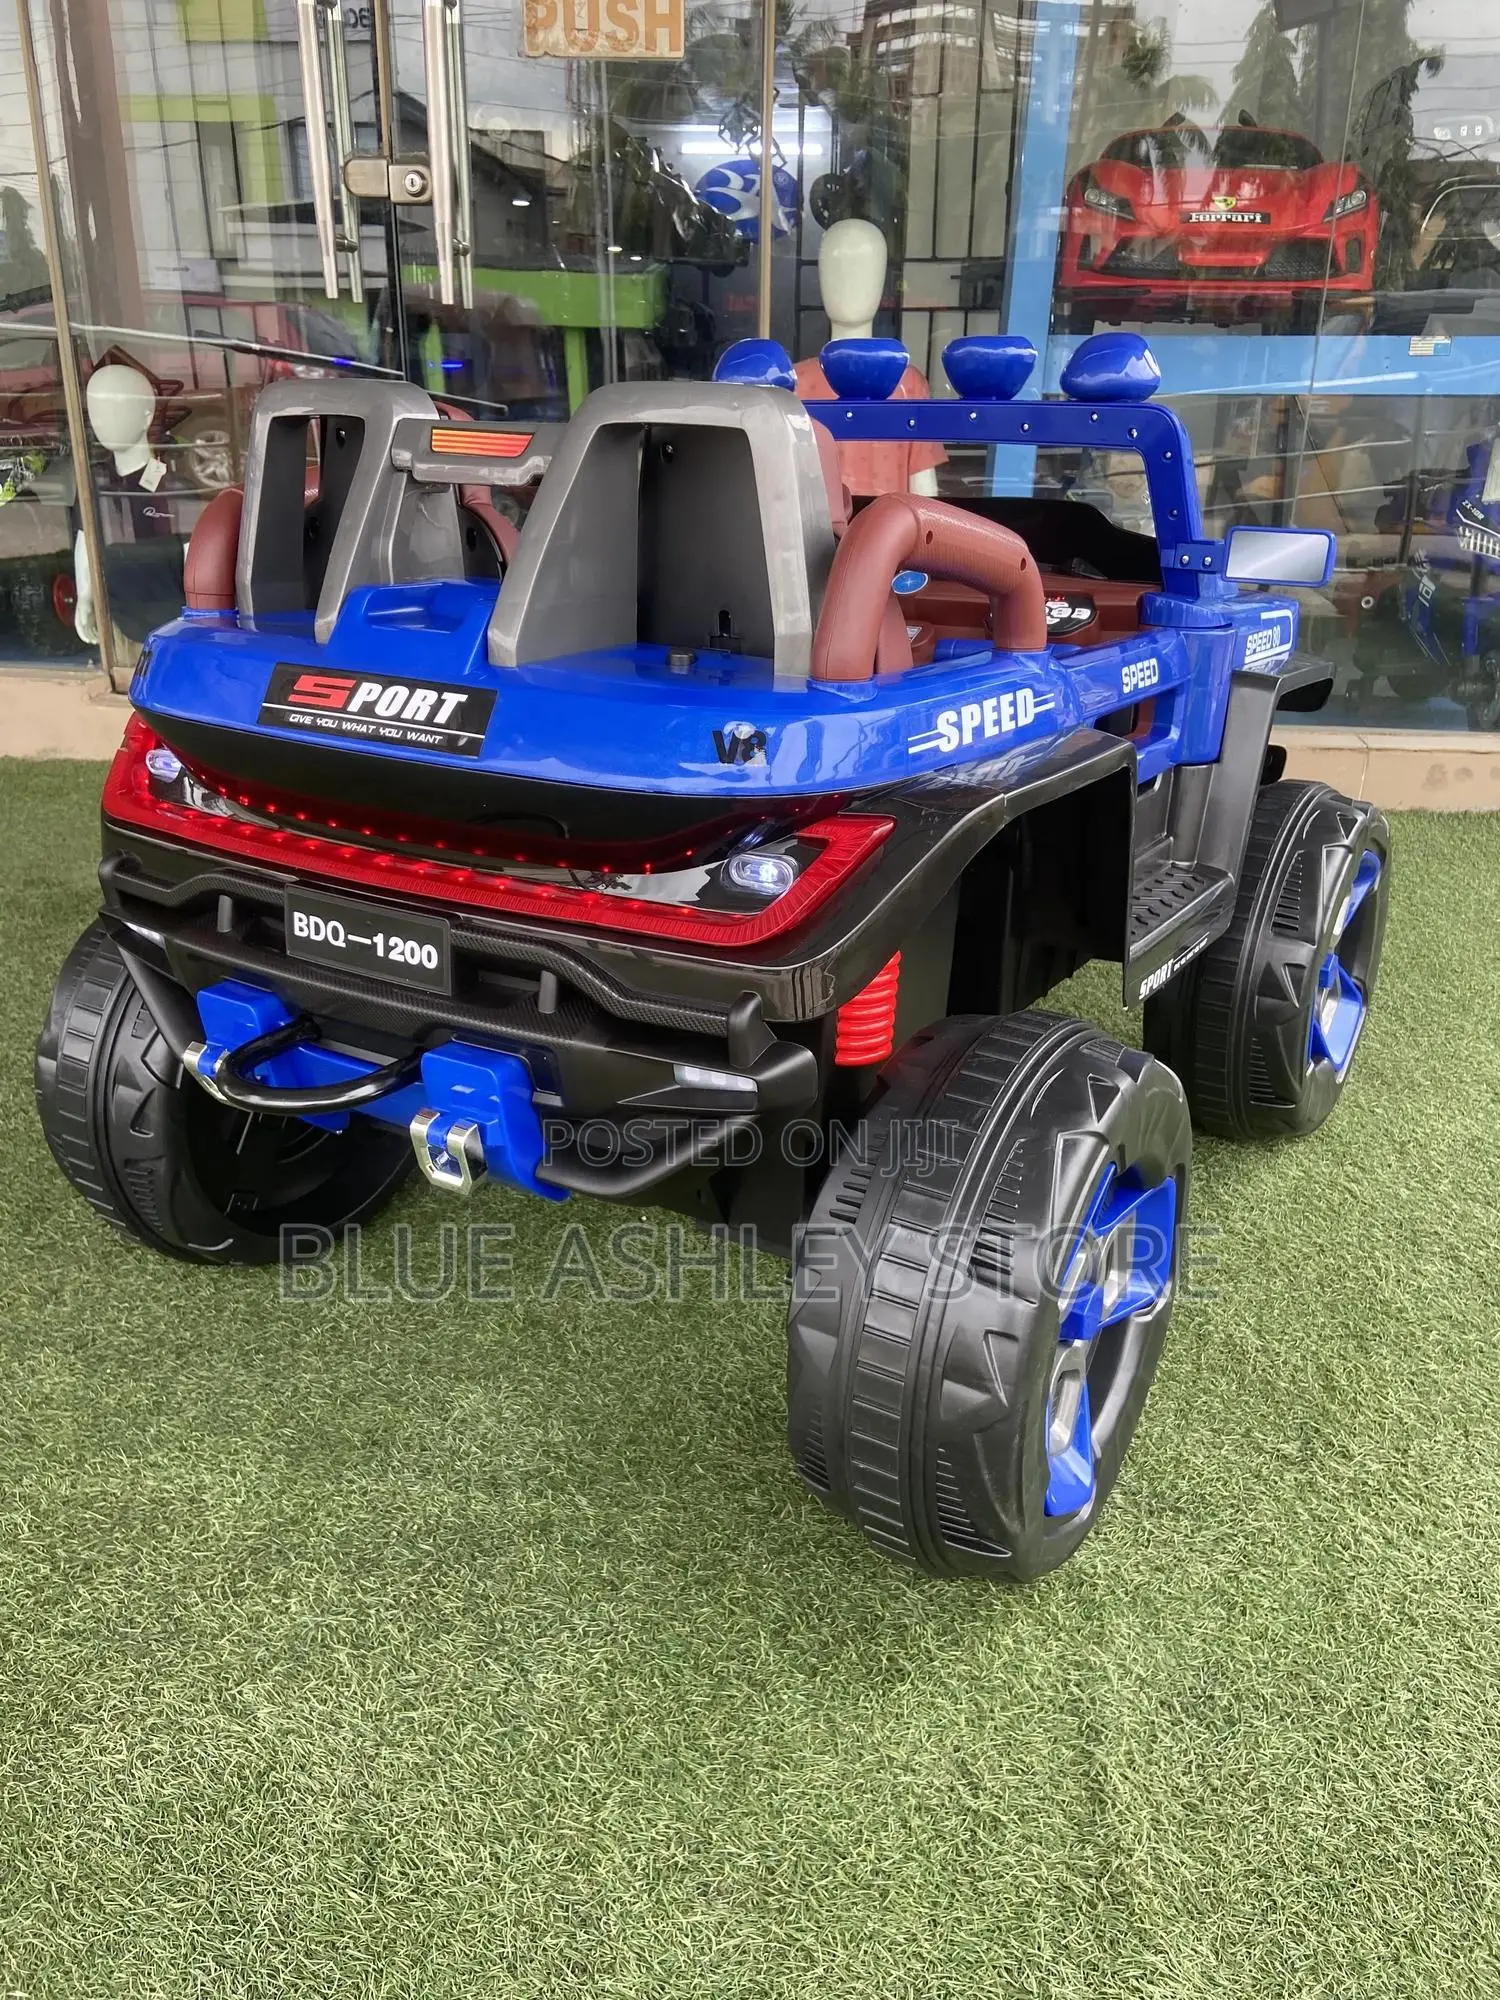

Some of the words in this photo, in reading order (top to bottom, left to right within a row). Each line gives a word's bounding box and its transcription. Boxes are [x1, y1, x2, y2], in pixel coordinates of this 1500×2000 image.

[525, 0, 681, 52] PUSH
[1189, 212, 1262, 222] Ferrari
[1246, 629, 1273, 656] SPEED
[1121, 657, 1159, 694] SPEED
[288, 674, 468, 724] SPORT
[289, 713, 312, 724] GIVE
[316, 717, 338, 728] YOU
[342, 722, 376, 734] WHAT
[379, 726, 403, 738] YOU
[406, 731, 443, 744] WANT
[926, 687, 1036, 753] SPEED
[1139, 958, 1174, 1000] SPORT
